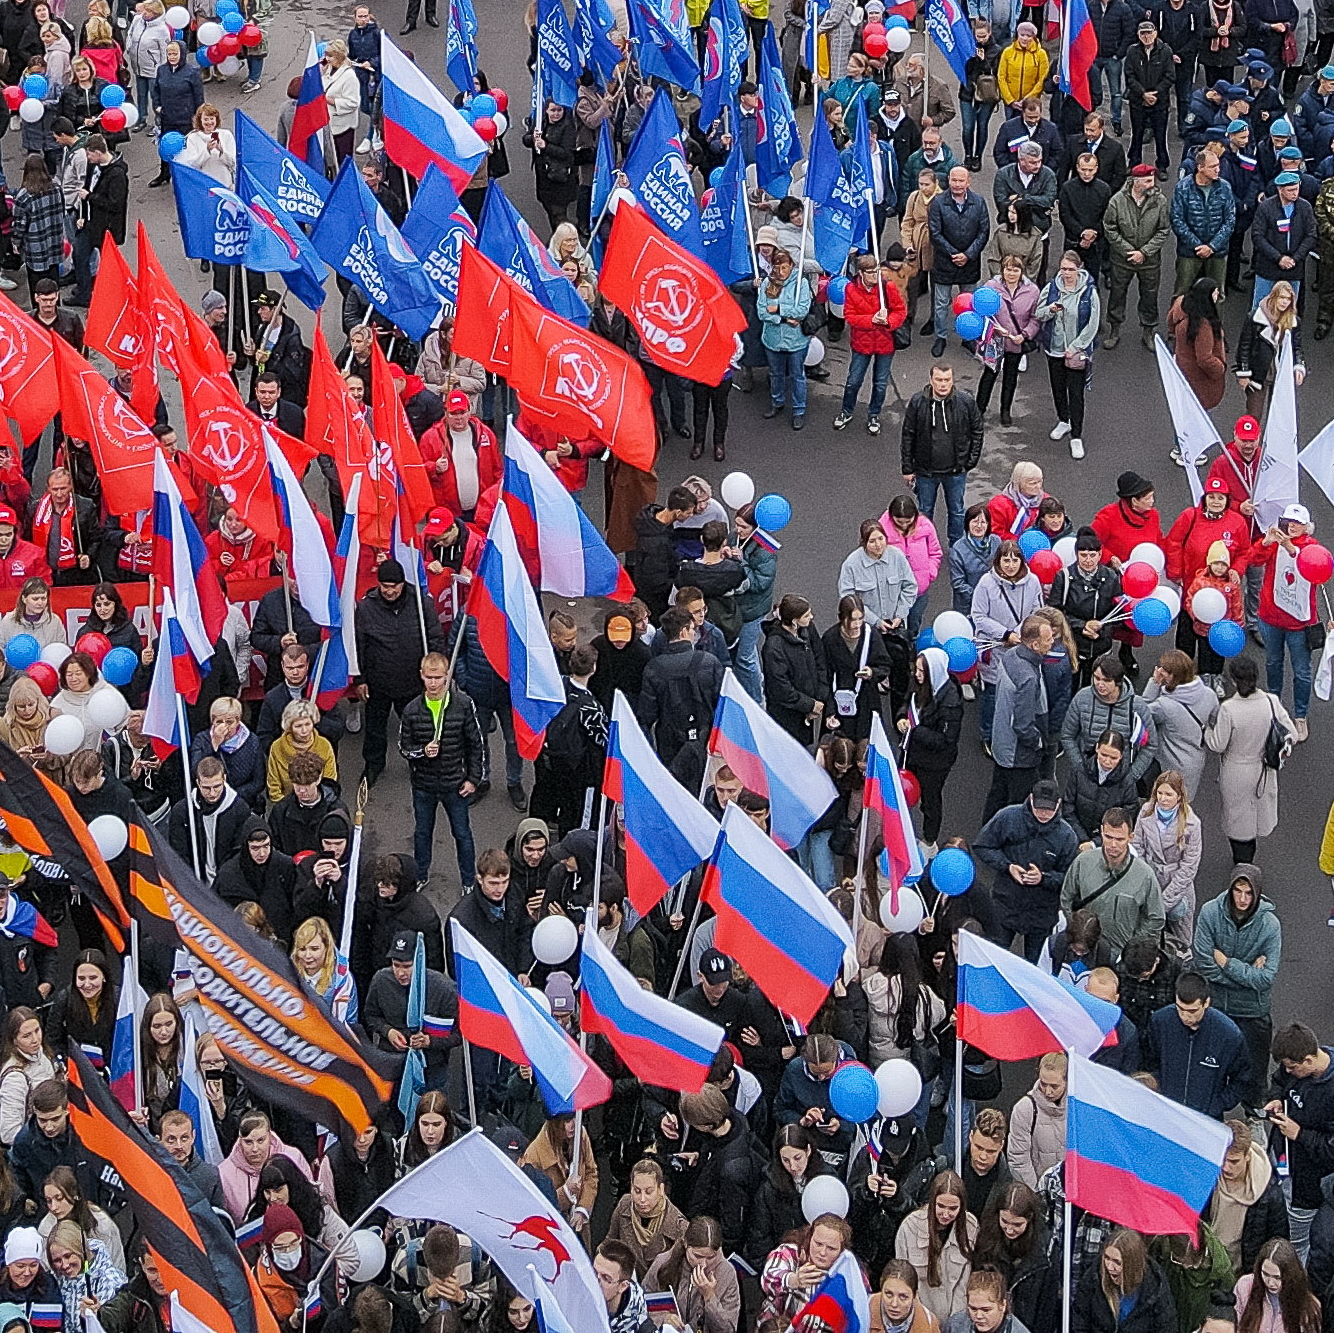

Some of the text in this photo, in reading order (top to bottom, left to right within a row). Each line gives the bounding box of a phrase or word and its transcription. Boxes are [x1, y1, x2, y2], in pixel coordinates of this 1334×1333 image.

[277, 199, 322, 218] РОССИ
[278, 186, 324, 209] ЕДИНА
[639, 182, 683, 231] РОССИЯ
[645, 172, 690, 221] ЕДИНАЯ
[214, 232, 248, 244] ЕДИ
[215, 244, 247, 257] РОС
[428, 251, 461, 279] ЕДИ
[423, 261, 459, 295] РОСС
